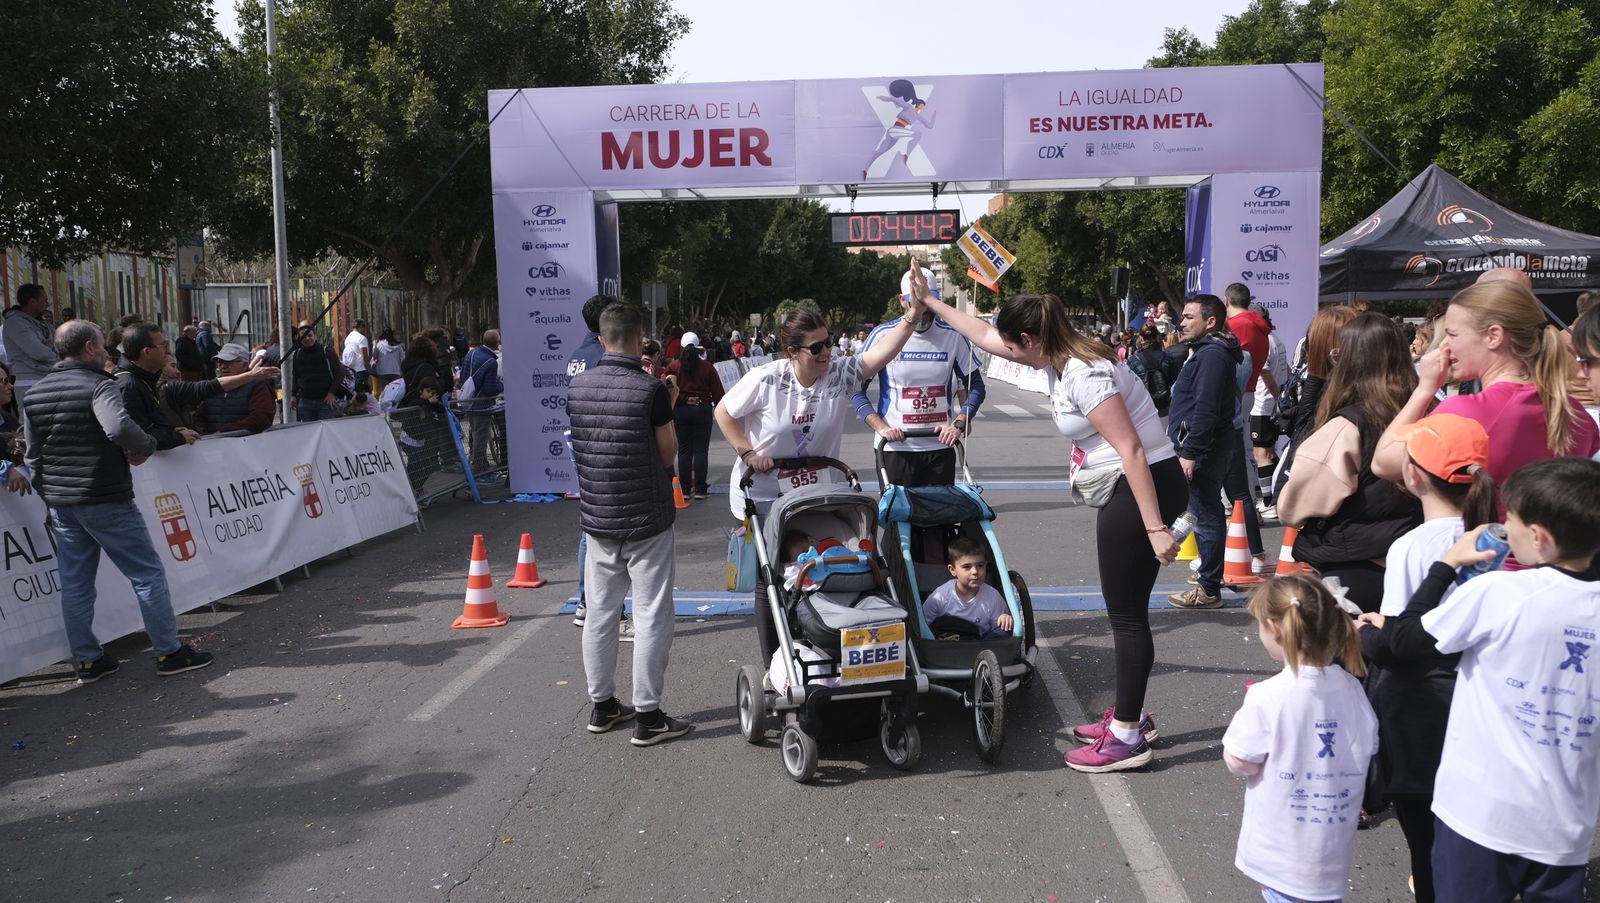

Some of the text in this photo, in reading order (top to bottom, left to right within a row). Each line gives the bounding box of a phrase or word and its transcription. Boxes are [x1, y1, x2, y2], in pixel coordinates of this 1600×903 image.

[1058, 86, 1183, 106] LA IGUALDAD
[609, 101, 760, 122] CARRERA DE LA
[1029, 112, 1212, 133] ES NUESTRA META.
[601, 127, 772, 170] MUJER
[1038, 143, 1068, 159] CDX
[1101, 141, 1136, 150] ALMERÍA
[523, 218, 566, 226] HYUNDAI
[849, 213, 955, 242] 00:44:42
[1255, 224, 1293, 233] cajamar
[535, 241, 570, 251] cajamar
[970, 232, 1005, 270] BEBÉ
[1246, 249, 1278, 262] CASI
[528, 265, 559, 279] CASI
[1187, 264, 1203, 292] CDX
[1256, 271, 1290, 280] vithas
[539, 287, 571, 296] vithas
[535, 313, 571, 325] aqualia
[540, 353, 563, 361] Clece
[541, 395, 566, 409] ego
[912, 398, 937, 410] 954
[328, 445, 394, 485] ALMERÍA
[790, 472, 818, 489] 955
[205, 468, 296, 518] ALMERÍA
[335, 482, 372, 505] CIUDAD
[214, 513, 264, 544] CIUDAD
[1564, 629, 1597, 641] MUJER
[849, 642, 899, 666] BEBÉ
[1315, 722, 1338, 730] MUJER
